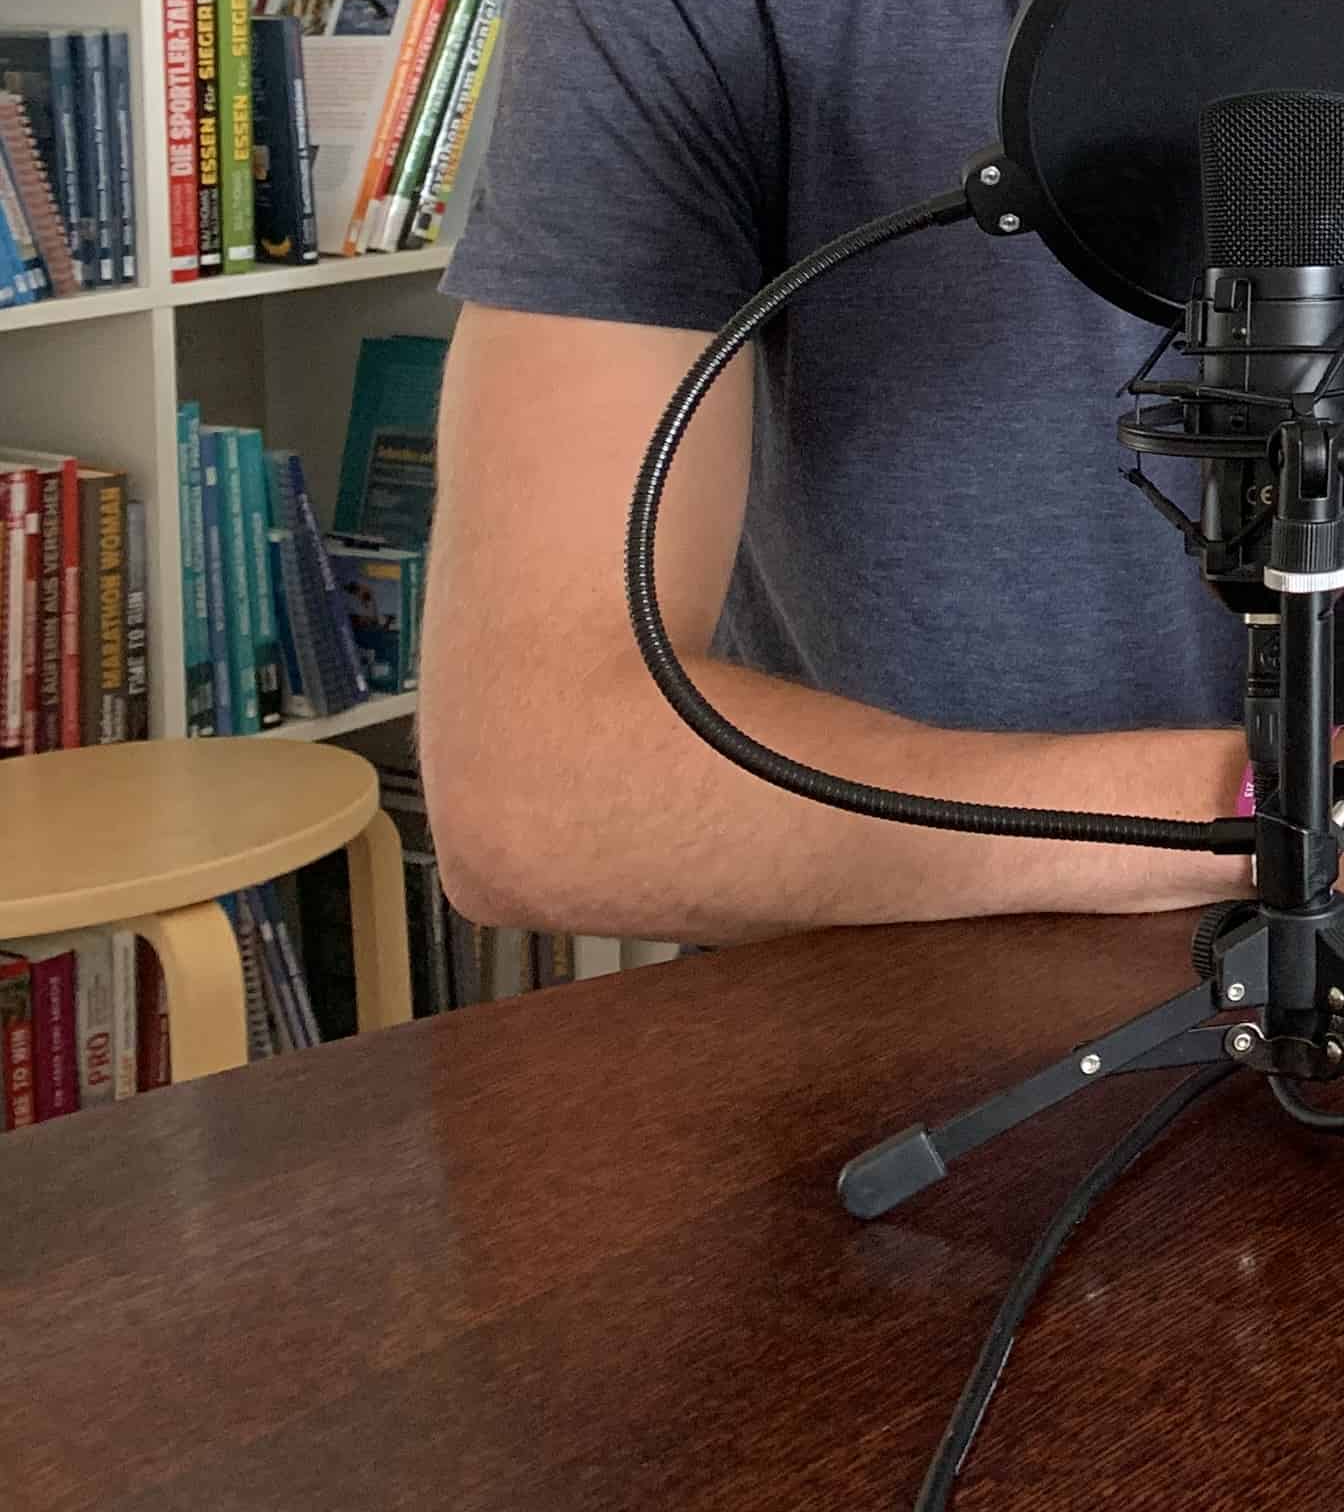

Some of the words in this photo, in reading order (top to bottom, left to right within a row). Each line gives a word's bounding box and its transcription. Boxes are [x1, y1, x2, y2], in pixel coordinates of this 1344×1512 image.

[200, 117, 217, 185] ESSEN
[232, 95, 249, 161] ESSEN
[170, 142, 193, 177] DIE
[100, 487, 121, 570] WOMAN
[101, 574, 121, 689] MARATHON
[127, 591, 145, 624] RUN
[128, 628, 145, 649] TO
[128, 655, 146, 695] TIME
[86, 1032, 112, 1086] PRO
